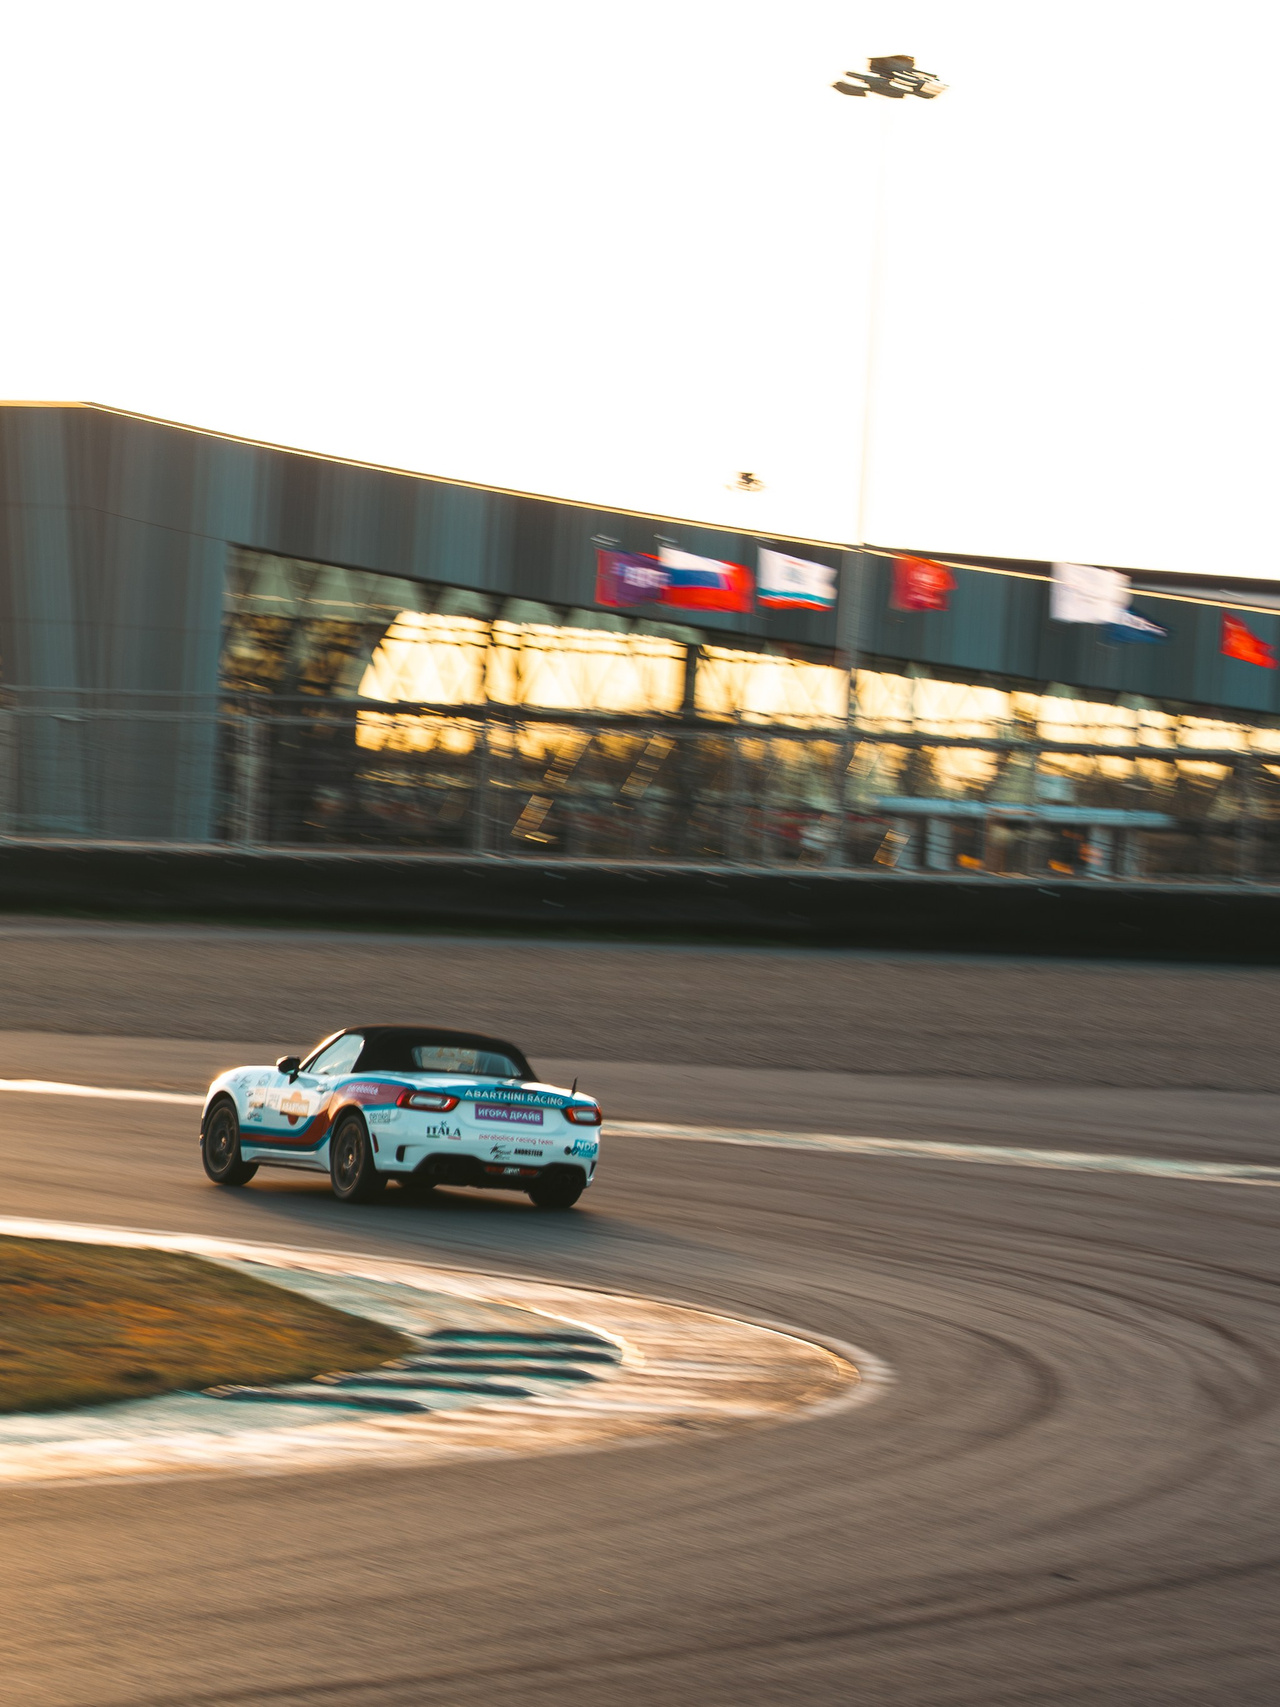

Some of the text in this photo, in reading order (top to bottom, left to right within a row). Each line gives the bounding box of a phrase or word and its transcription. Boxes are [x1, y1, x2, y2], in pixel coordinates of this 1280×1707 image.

[464, 1089, 564, 1106] ABARTHINI RACING
[478, 1108, 541, 1122] ИГОРА ДРАЙВ
[478, 1133, 515, 1142] parabolica
[516, 1136, 537, 1145] racing
